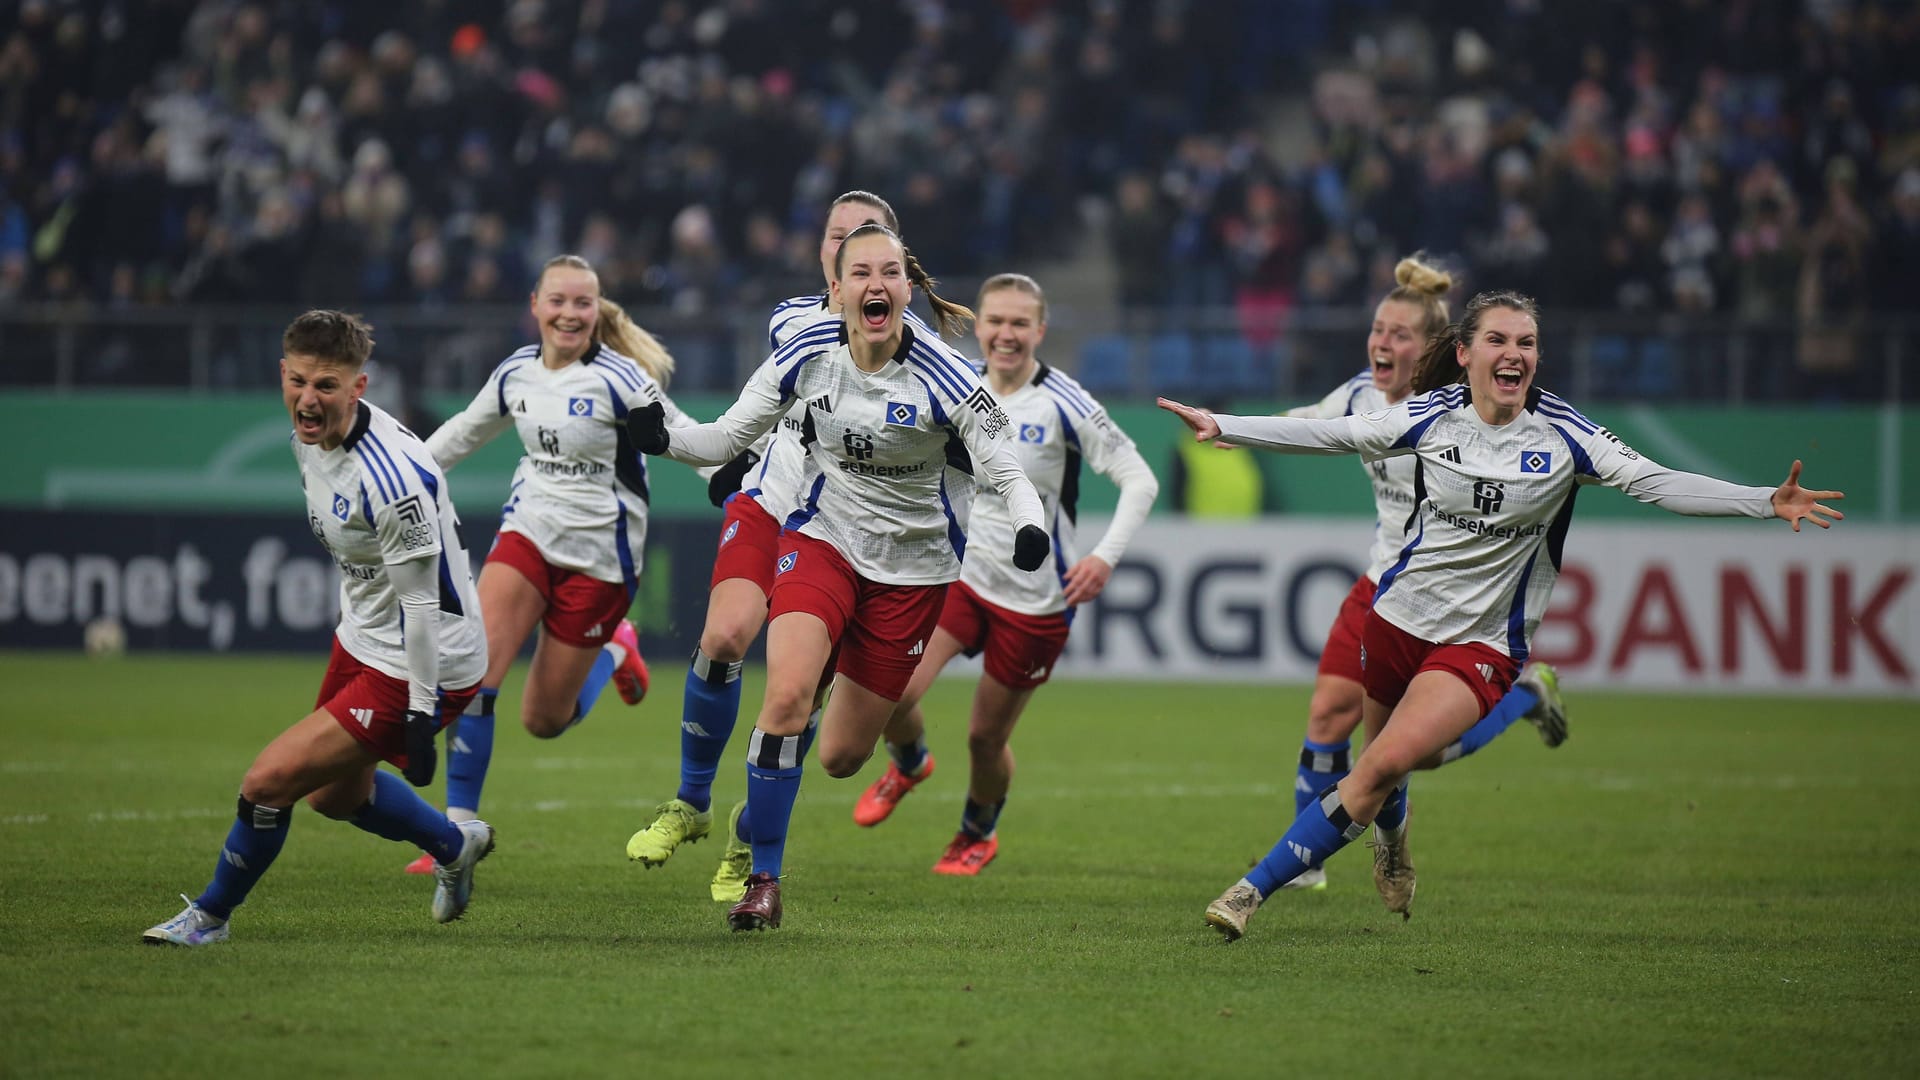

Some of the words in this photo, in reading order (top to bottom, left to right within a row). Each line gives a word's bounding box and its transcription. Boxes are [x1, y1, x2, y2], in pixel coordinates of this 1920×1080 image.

[839, 460, 927, 476] seMerkur
[404, 533, 433, 551] GROU
[1428, 498, 1545, 540] HanseMerkur
[242, 537, 340, 632] fe
[1063, 558, 1362, 664] RGO
[1526, 560, 1914, 682] BANK
